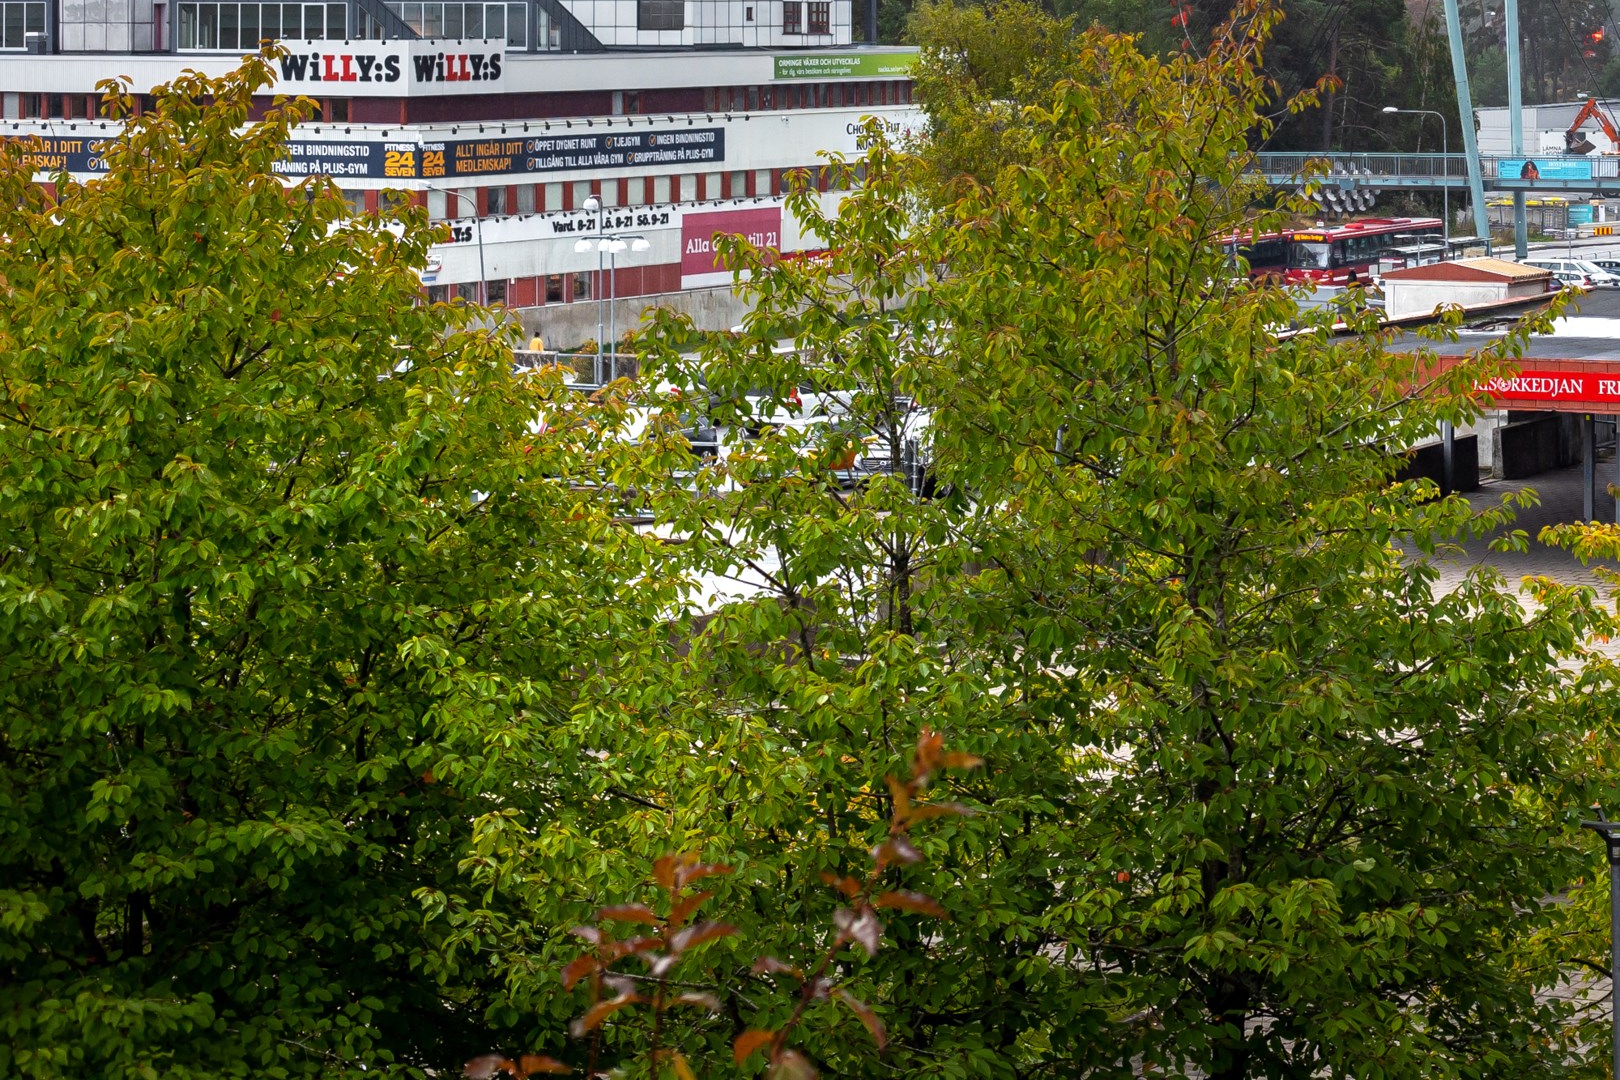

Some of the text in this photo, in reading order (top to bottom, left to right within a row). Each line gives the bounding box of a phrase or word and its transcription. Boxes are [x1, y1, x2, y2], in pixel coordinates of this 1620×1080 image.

[534, 138, 597, 152] ÖPPET DYGNET RUNT
[613, 136, 641, 148] TJEJGYM
[656, 132, 715, 145] INGEN BINDNINGSTID
[60, 141, 82, 153] DITT
[306, 144, 369, 157] BINDNINGSTID
[385, 143, 415, 152] FITNESS
[422, 143, 445, 152] FITNESS
[456, 144, 474, 158] ALLT
[476, 140, 499, 156] INGÅR
[506, 141, 523, 155] DITT
[677, 147, 685, 160] PÅ
[685, 148, 714, 160] PLUS-GYM
[385, 151, 415, 167] 24
[422, 151, 445, 167] 24
[456, 157, 511, 173] MEDLEMSKAP!
[535, 152, 624, 169] TILLGÅNG TILL ALLA VÅRA GYM
[310, 159, 321, 173] PÅ
[322, 162, 368, 175] PLUS-GYM
[385, 167, 415, 177] SEVEN
[422, 167, 445, 177] SEVEN
[552, 220, 575, 233] Vard.
[577, 218, 596, 230] 8-21
[615, 216, 633, 227] 8-21
[651, 213, 669, 225] 9-21
[686, 238, 710, 254] Alla
[748, 232, 763, 248] till
[766, 231, 777, 247] 21
